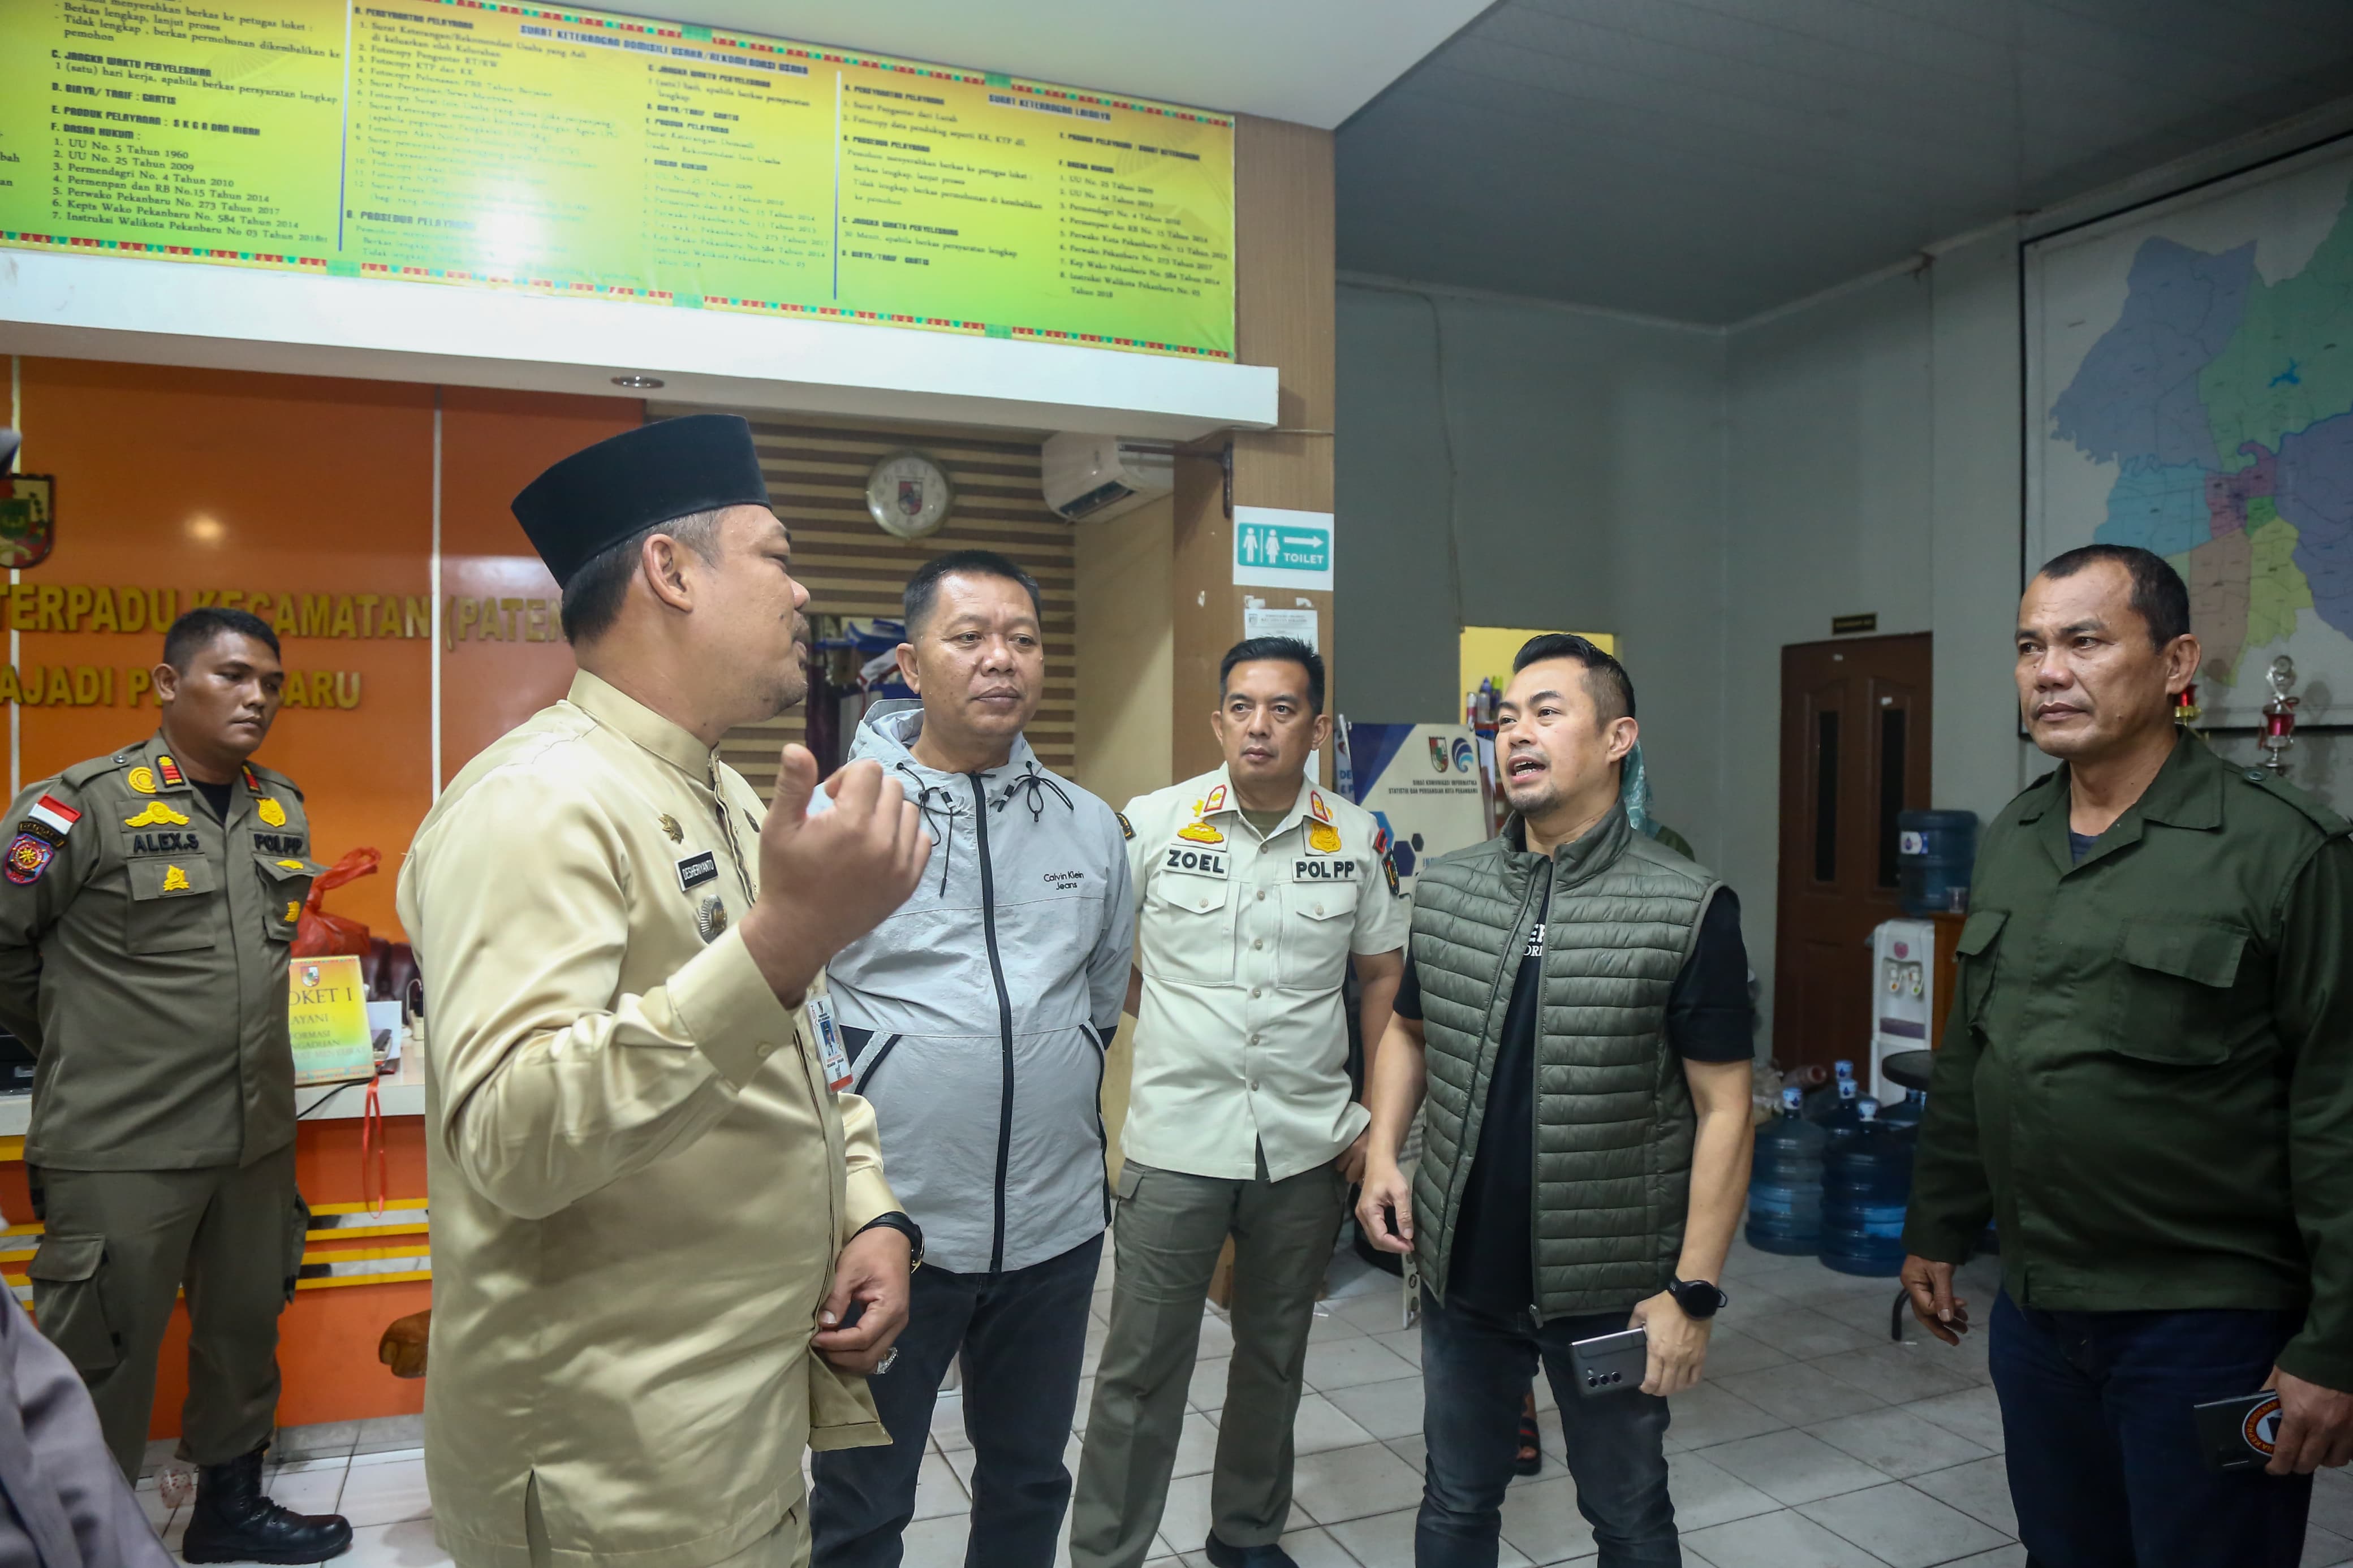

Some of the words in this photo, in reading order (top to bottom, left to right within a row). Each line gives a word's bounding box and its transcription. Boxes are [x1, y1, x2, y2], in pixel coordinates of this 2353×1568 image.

[64, 2, 100, 15] Berkas
[154, 14, 183, 27] lanjut
[188, 21, 221, 31] proses
[186, 6, 219, 19] berkas
[223, 12, 235, 21] ke
[239, 16, 277, 28] petugas
[282, 20, 305, 31] loket
[63, 14, 94, 26] Tidak
[100, 19, 141, 35] lengkap
[154, 27, 187, 39] berkas
[191, 34, 255, 47] permohonan
[260, 41, 325, 57] dikembalikan
[330, 49, 341, 58] ke
[64, 29, 114, 41] pemohon
[66, 63, 98, 75] (satu)
[103, 67, 123, 77] hari
[161, 75, 197, 87] apabila
[202, 79, 235, 91] berkas
[239, 85, 295, 98] persyaratan
[300, 90, 338, 105] lengkap
[68, 139, 87, 148] UU
[92, 141, 110, 151] No.
[127, 145, 160, 156] Tahun
[165, 150, 189, 159] 1960
[68, 150, 87, 161] UU
[92, 153, 110, 163] No.
[132, 158, 165, 169] Tahun
[170, 162, 194, 172] 2009
[53, 162, 62, 171] 3.
[68, 163, 134, 179] Permendagri
[140, 171, 158, 180] No.
[173, 173, 206, 185] Tahun
[210, 178, 234, 187] 2010
[67, 187, 111, 200] Perwako
[118, 192, 170, 205] Pekanbaru
[176, 198, 193, 208] No.
[199, 201, 216, 211] 273
[221, 202, 253, 213] Tahun
[68, 175, 127, 190] Permenpan
[131, 182, 150, 191] dan
[156, 184, 170, 193] RB
[210, 189, 242, 201] Tahun
[247, 193, 269, 203] 2014
[52, 199, 62, 208] 6.
[102, 203, 132, 214] Wako
[136, 206, 189, 219] Pekanbaru
[195, 211, 213, 221] No.
[239, 216, 272, 227] Tahun
[52, 211, 61, 220] 7.
[67, 212, 113, 224] Instruksi
[118, 217, 165, 229] Walikota
[170, 221, 222, 234] Pekanbaru
[262, 230, 294, 240] Tahun
[1283, 552, 1324, 564] TOILET
[1167, 849, 1224, 874] ZOEL
[1044, 872, 1067, 882] Calvin
[289, 988, 338, 1006] OKET
[291, 1013, 329, 1025] AYANI
